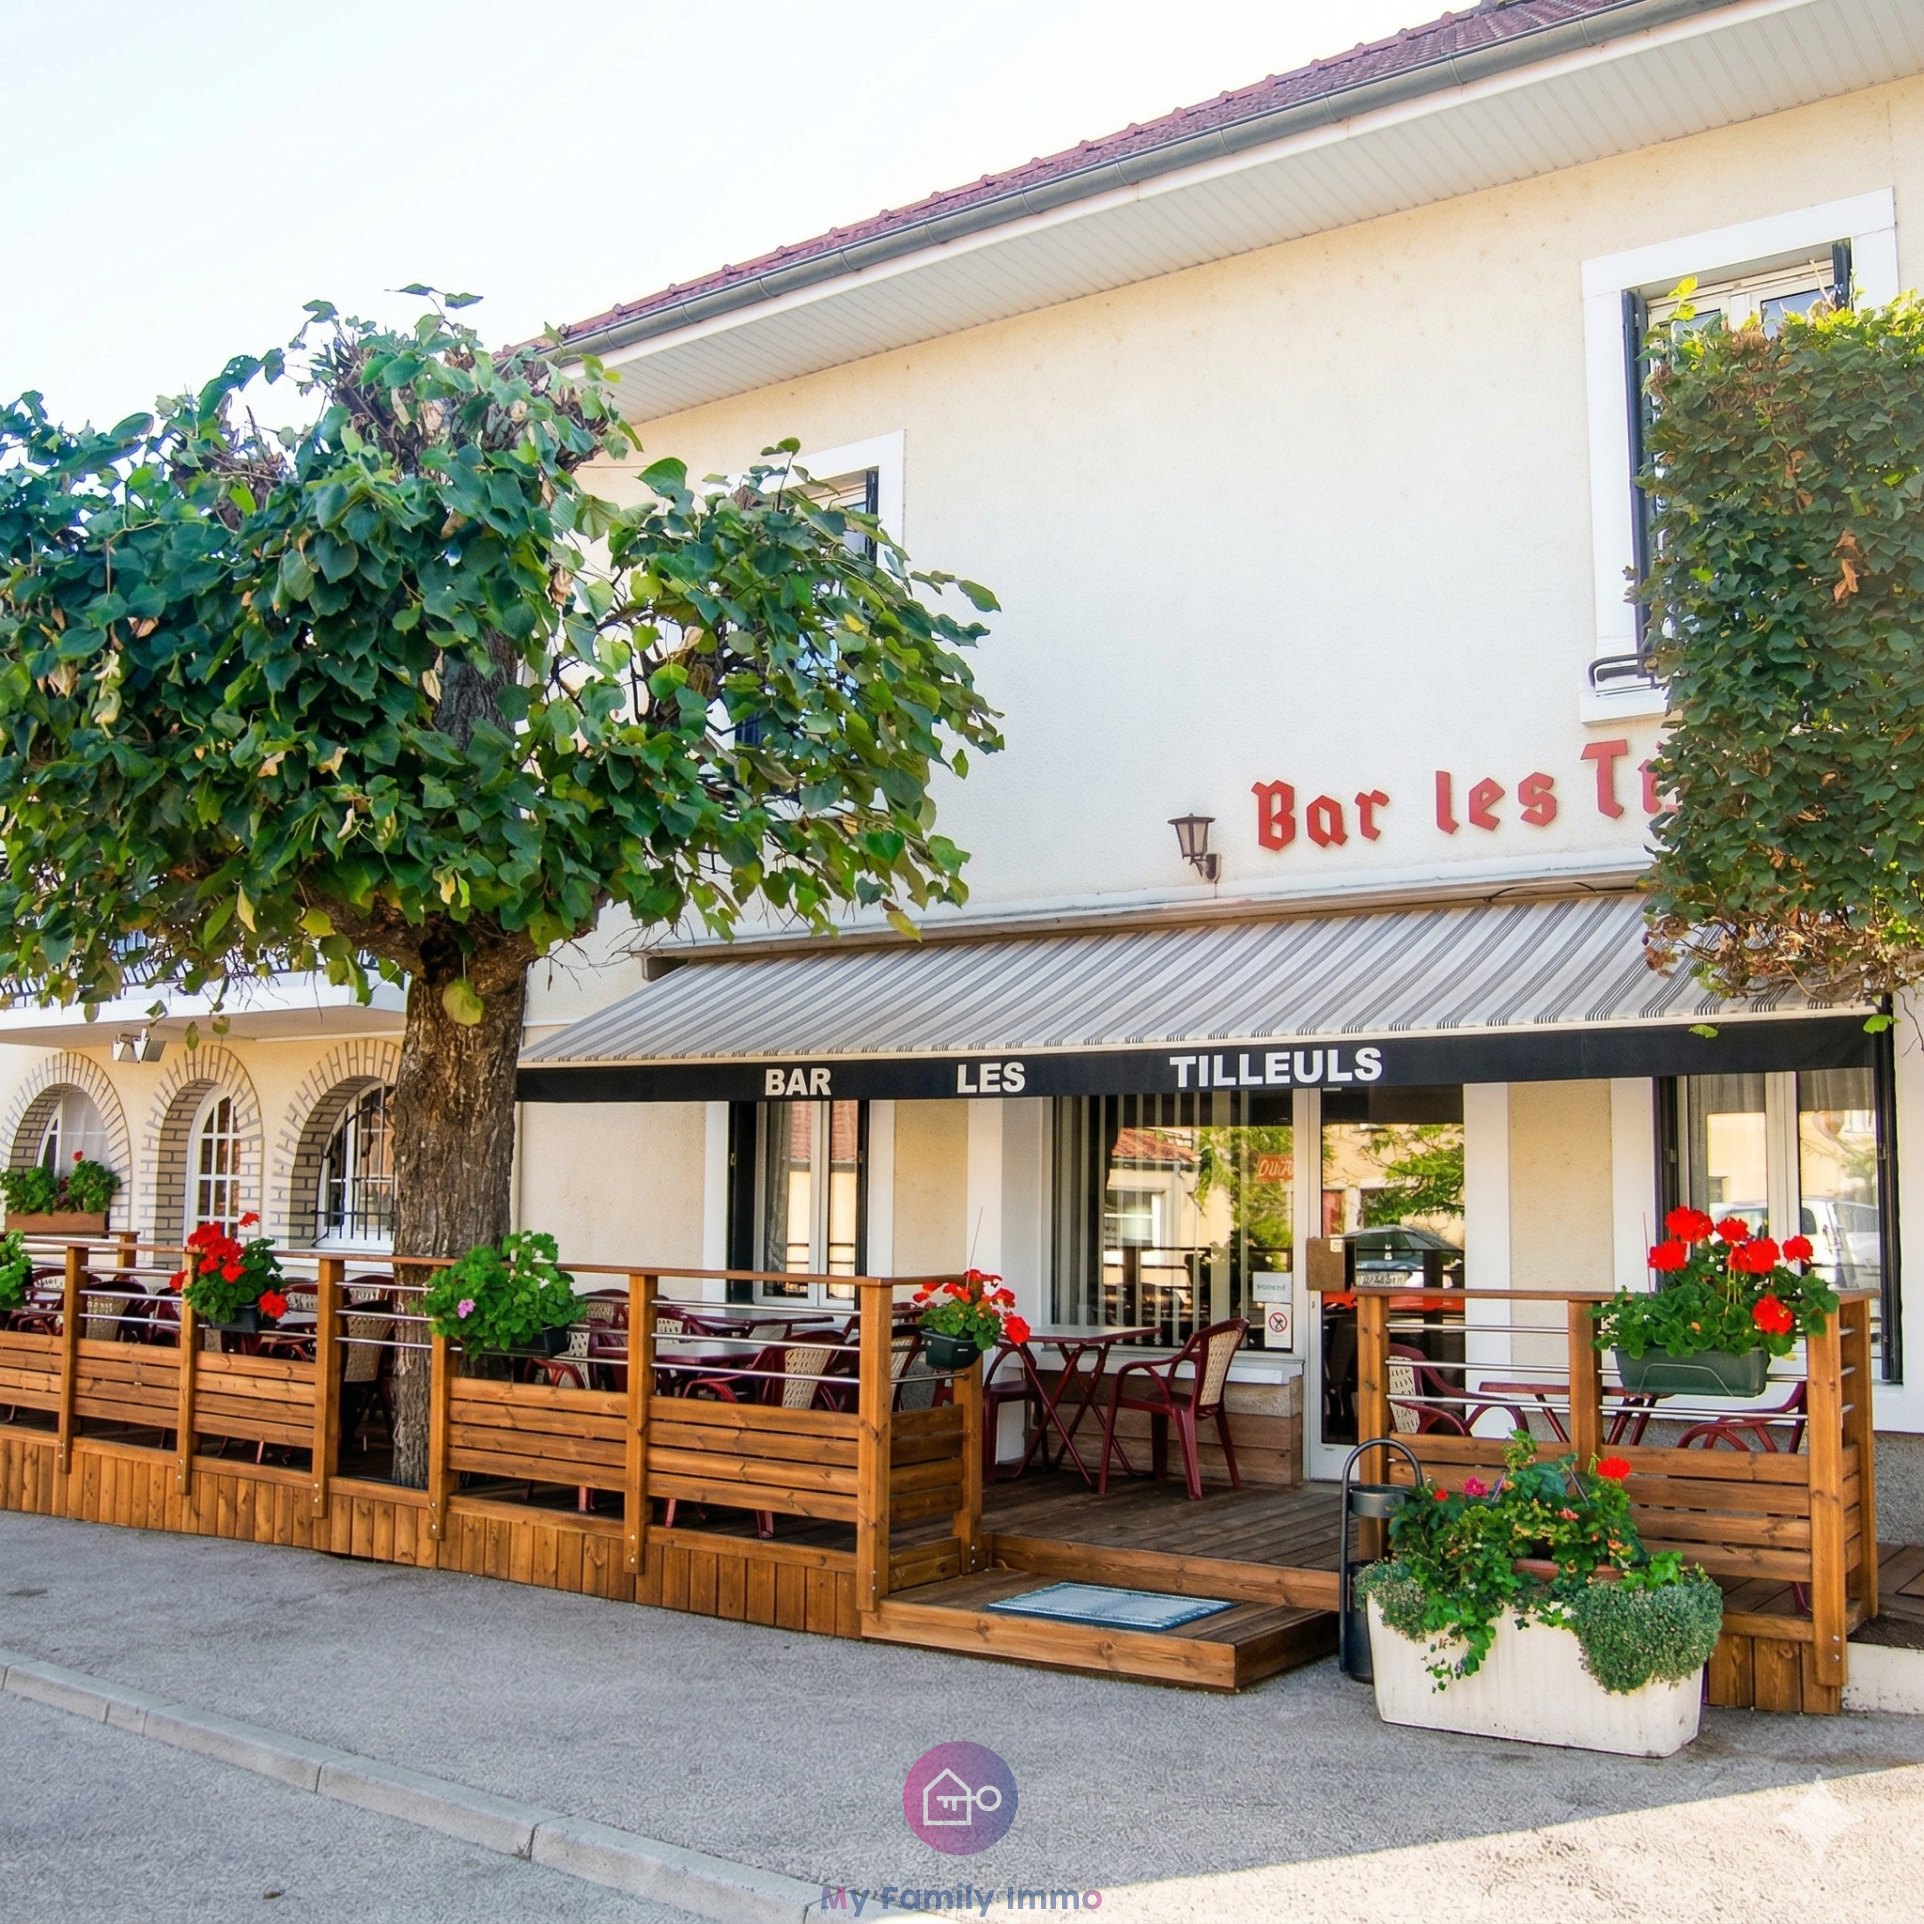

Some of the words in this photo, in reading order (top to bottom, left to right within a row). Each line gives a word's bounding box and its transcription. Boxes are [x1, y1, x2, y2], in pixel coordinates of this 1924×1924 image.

[1251, 779, 1390, 851] Bar
[1435, 770, 1558, 835] les
[765, 1067, 832, 1096] BAR
[956, 1061, 1026, 1094] LES
[1169, 1047, 1384, 1088] TILLEULS
